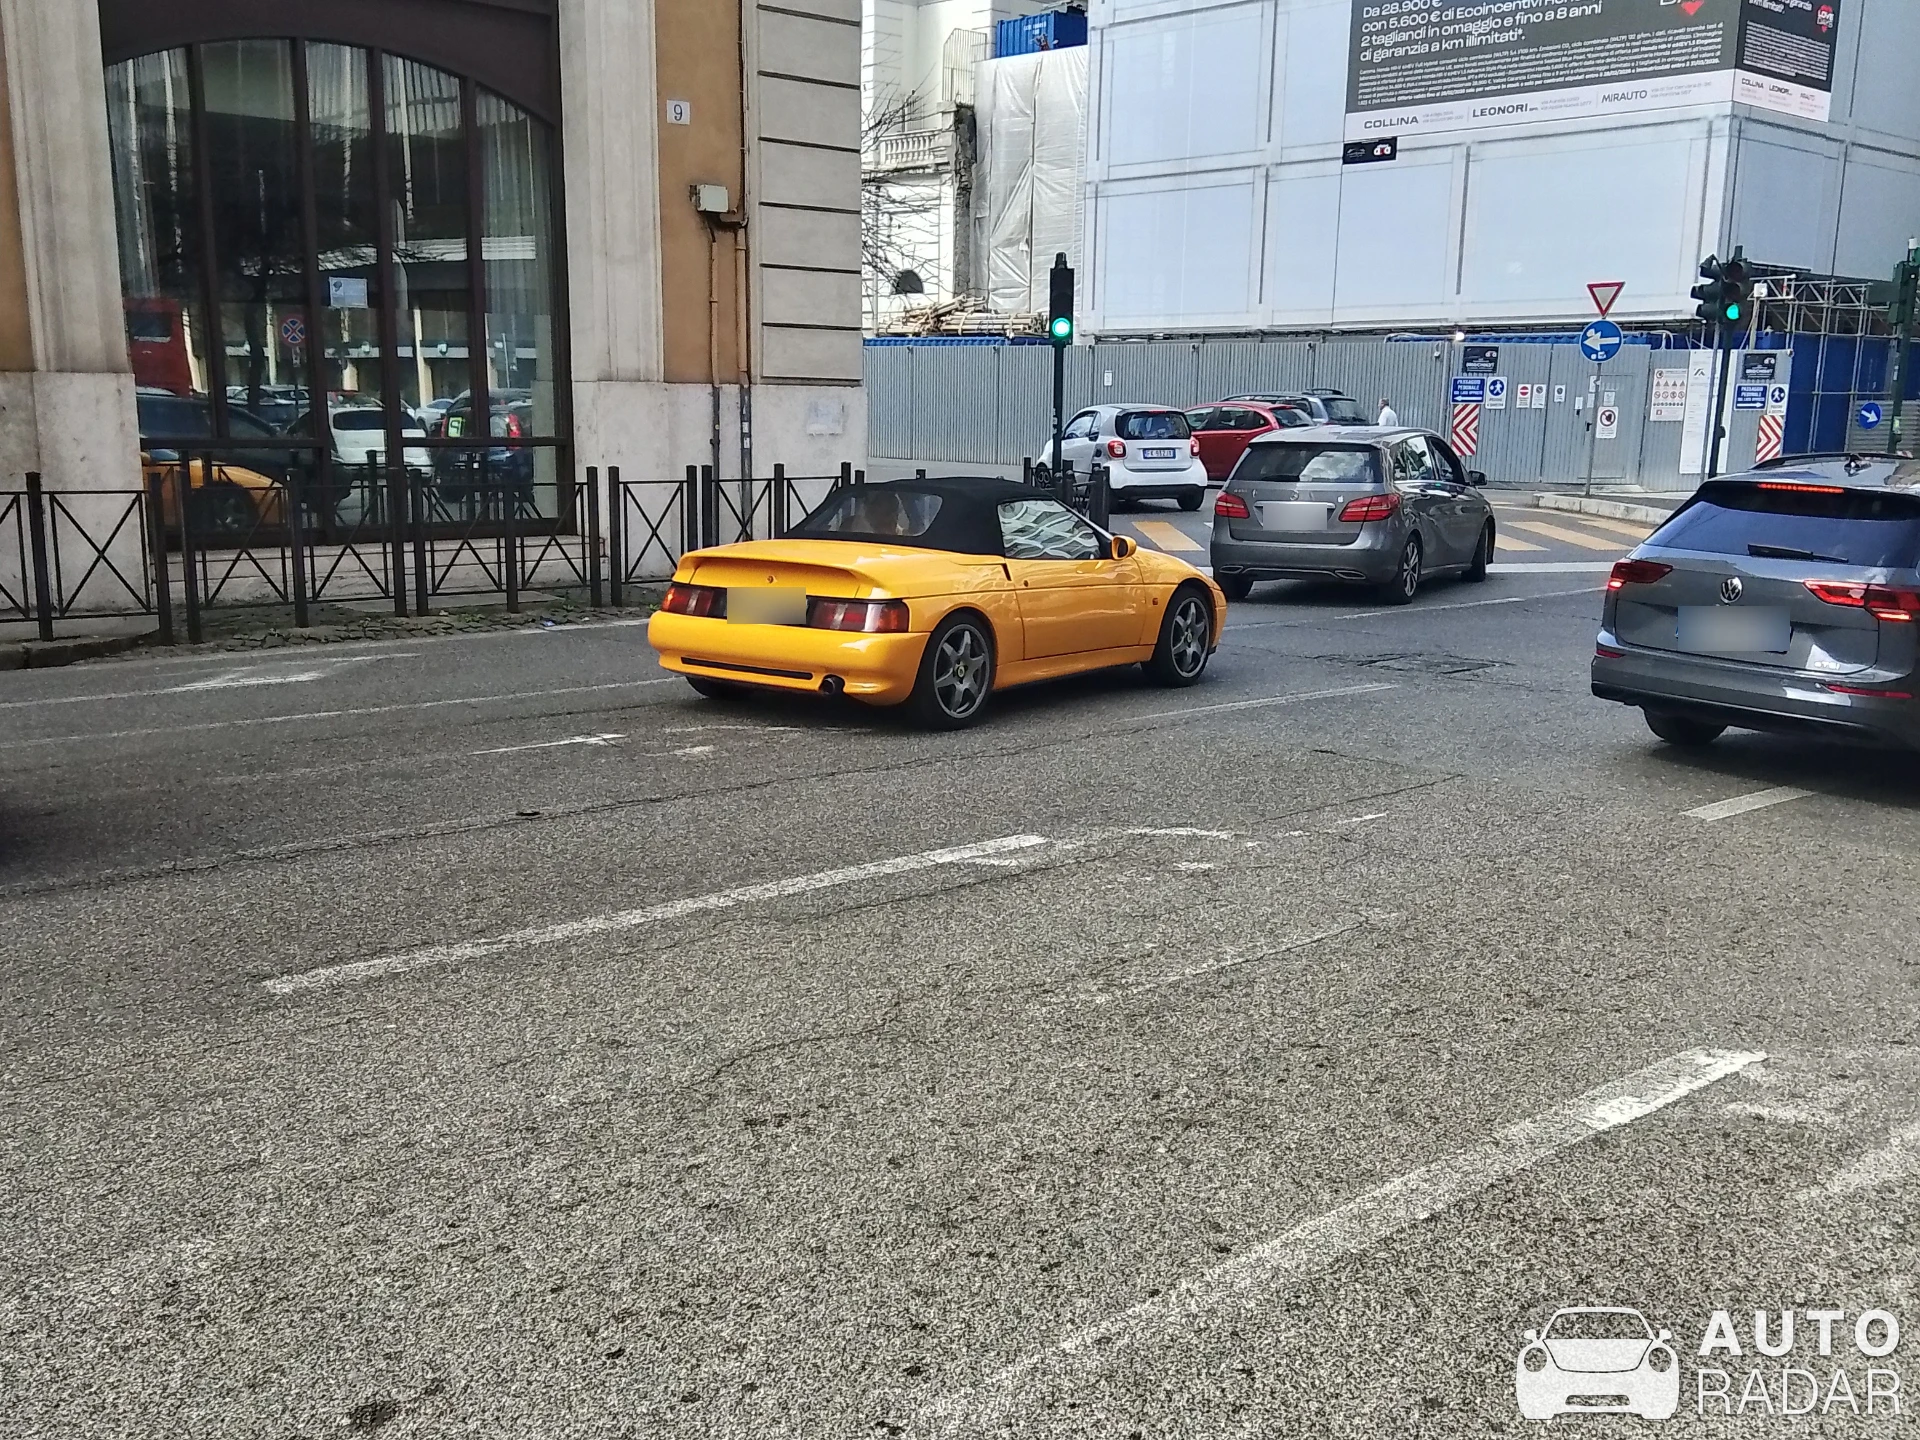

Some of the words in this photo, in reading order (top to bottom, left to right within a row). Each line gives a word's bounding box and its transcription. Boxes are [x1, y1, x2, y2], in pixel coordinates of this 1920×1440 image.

[1362, 21, 1387, 32] con
[1389, 12, 1428, 28] 5.600
[1430, 10, 1440, 22] €
[1442, 7, 1454, 20] di
[1456, 0, 1542, 19] Ecoincentivi
[1363, 7, 1380, 18] Da
[1382, 0, 1430, 15] 28.900
[1360, 36, 1370, 47] 2
[1372, 26, 1426, 46] tagliandi
[1428, 25, 1440, 37] in
[1442, 16, 1502, 36] omaggio
[1503, 16, 1513, 27] e
[1515, 11, 1543, 26] fino
[1545, 10, 1554, 20] a
[1556, 7, 1568, 19] 8
[1569, 0, 1602, 18] anni
[1360, 48, 1372, 62] di
[1372, 40, 1429, 62] garanzia
[1431, 42, 1440, 52] a
[1442, 38, 1464, 50] km
[1602, 90, 1648, 103] MIRAUTO
[674, 104, 683, 121] 9
[1472, 103, 1528, 118] LEONORI
[1364, 116, 1418, 129] COLLINA
